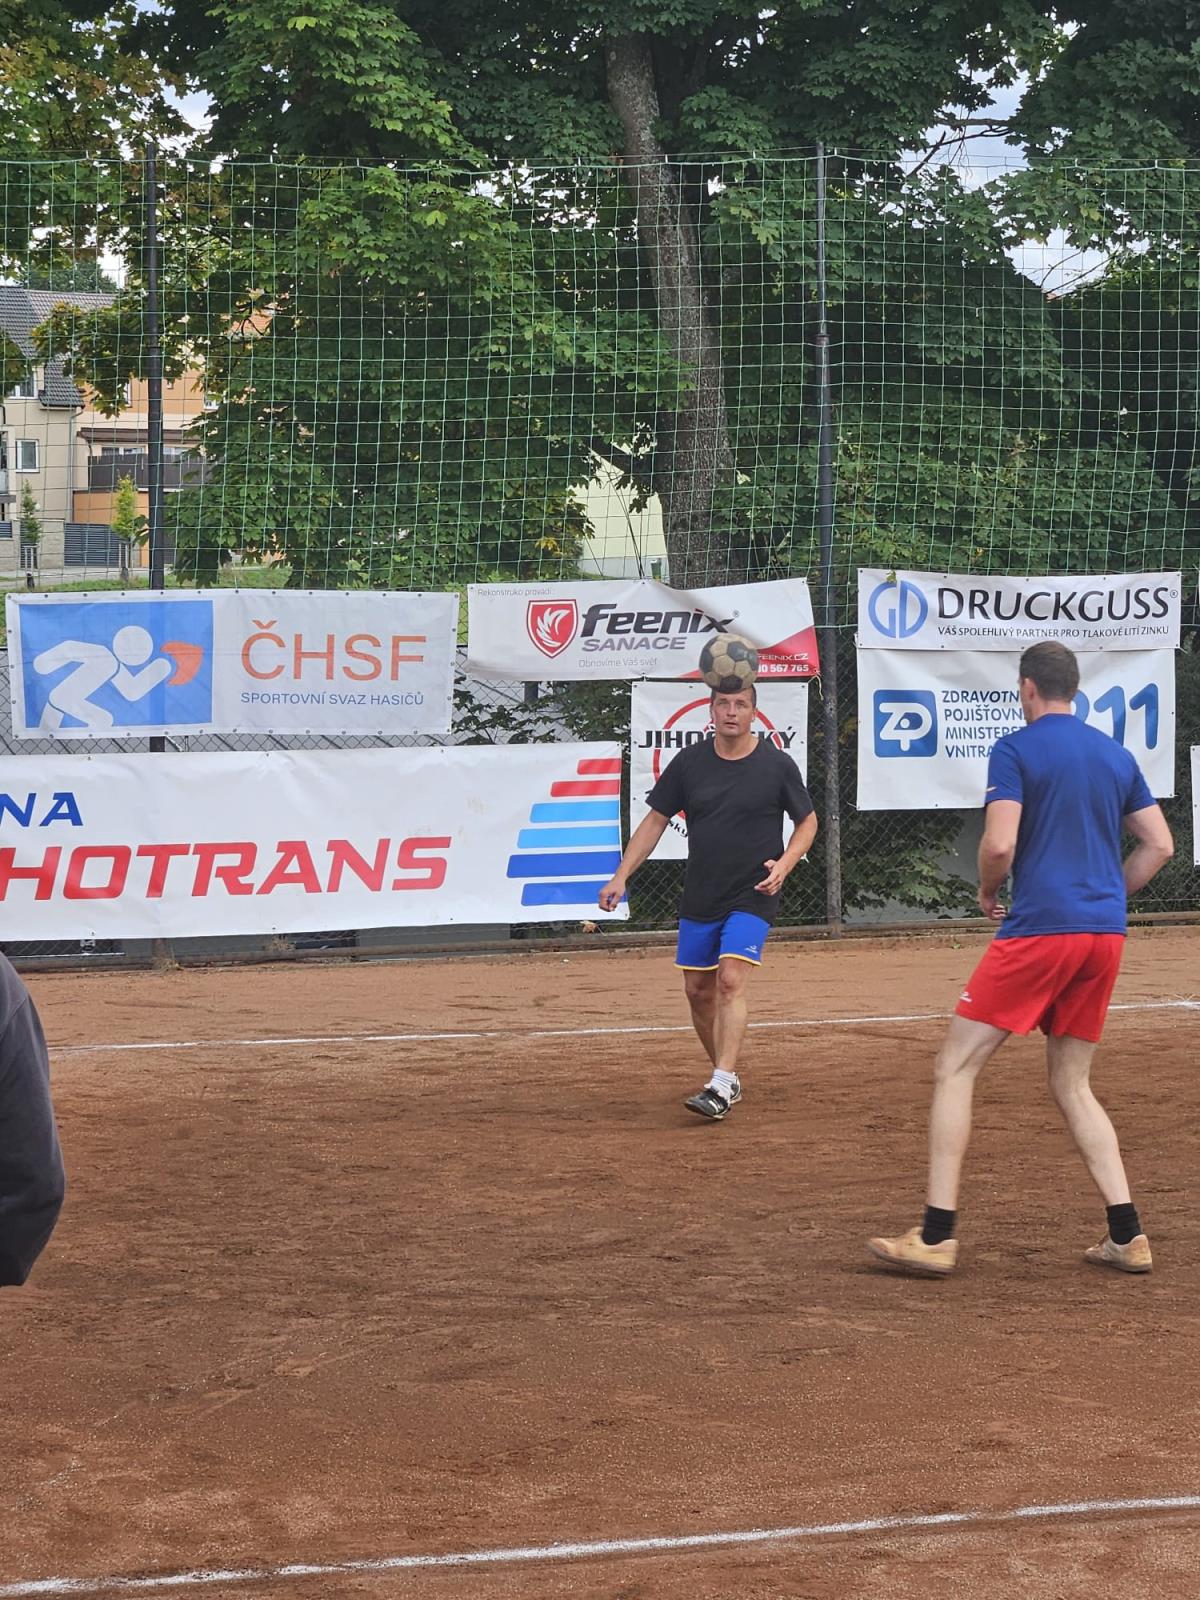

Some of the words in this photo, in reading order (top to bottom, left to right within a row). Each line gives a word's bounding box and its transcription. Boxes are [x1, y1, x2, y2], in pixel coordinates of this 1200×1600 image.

[938, 625, 957, 636] VÁŠ
[958, 626, 1014, 637] SPOLEHLIVÝ
[1016, 628, 1059, 637] PARTNER
[1060, 628, 1080, 637] PRO
[1081, 626, 1123, 638] TLAKOVÉ
[1124, 625, 1140, 636] LITÍ
[1141, 625, 1169, 635] ZINKU
[241, 619, 427, 681] ČHSF
[582, 636, 687, 652] SANACE
[241, 691, 326, 705] SPORTOVNÍ
[329, 694, 367, 705] SVAZ
[370, 691, 424, 706] HASIČŮ
[941, 690, 1020, 703] ZDRAVOTN
[944, 704, 1023, 721] POJIŠŤOVN
[945, 726, 1019, 740] MINISTER
[0, 792, 84, 828] NA
[0, 836, 452, 901] HOTRANS
